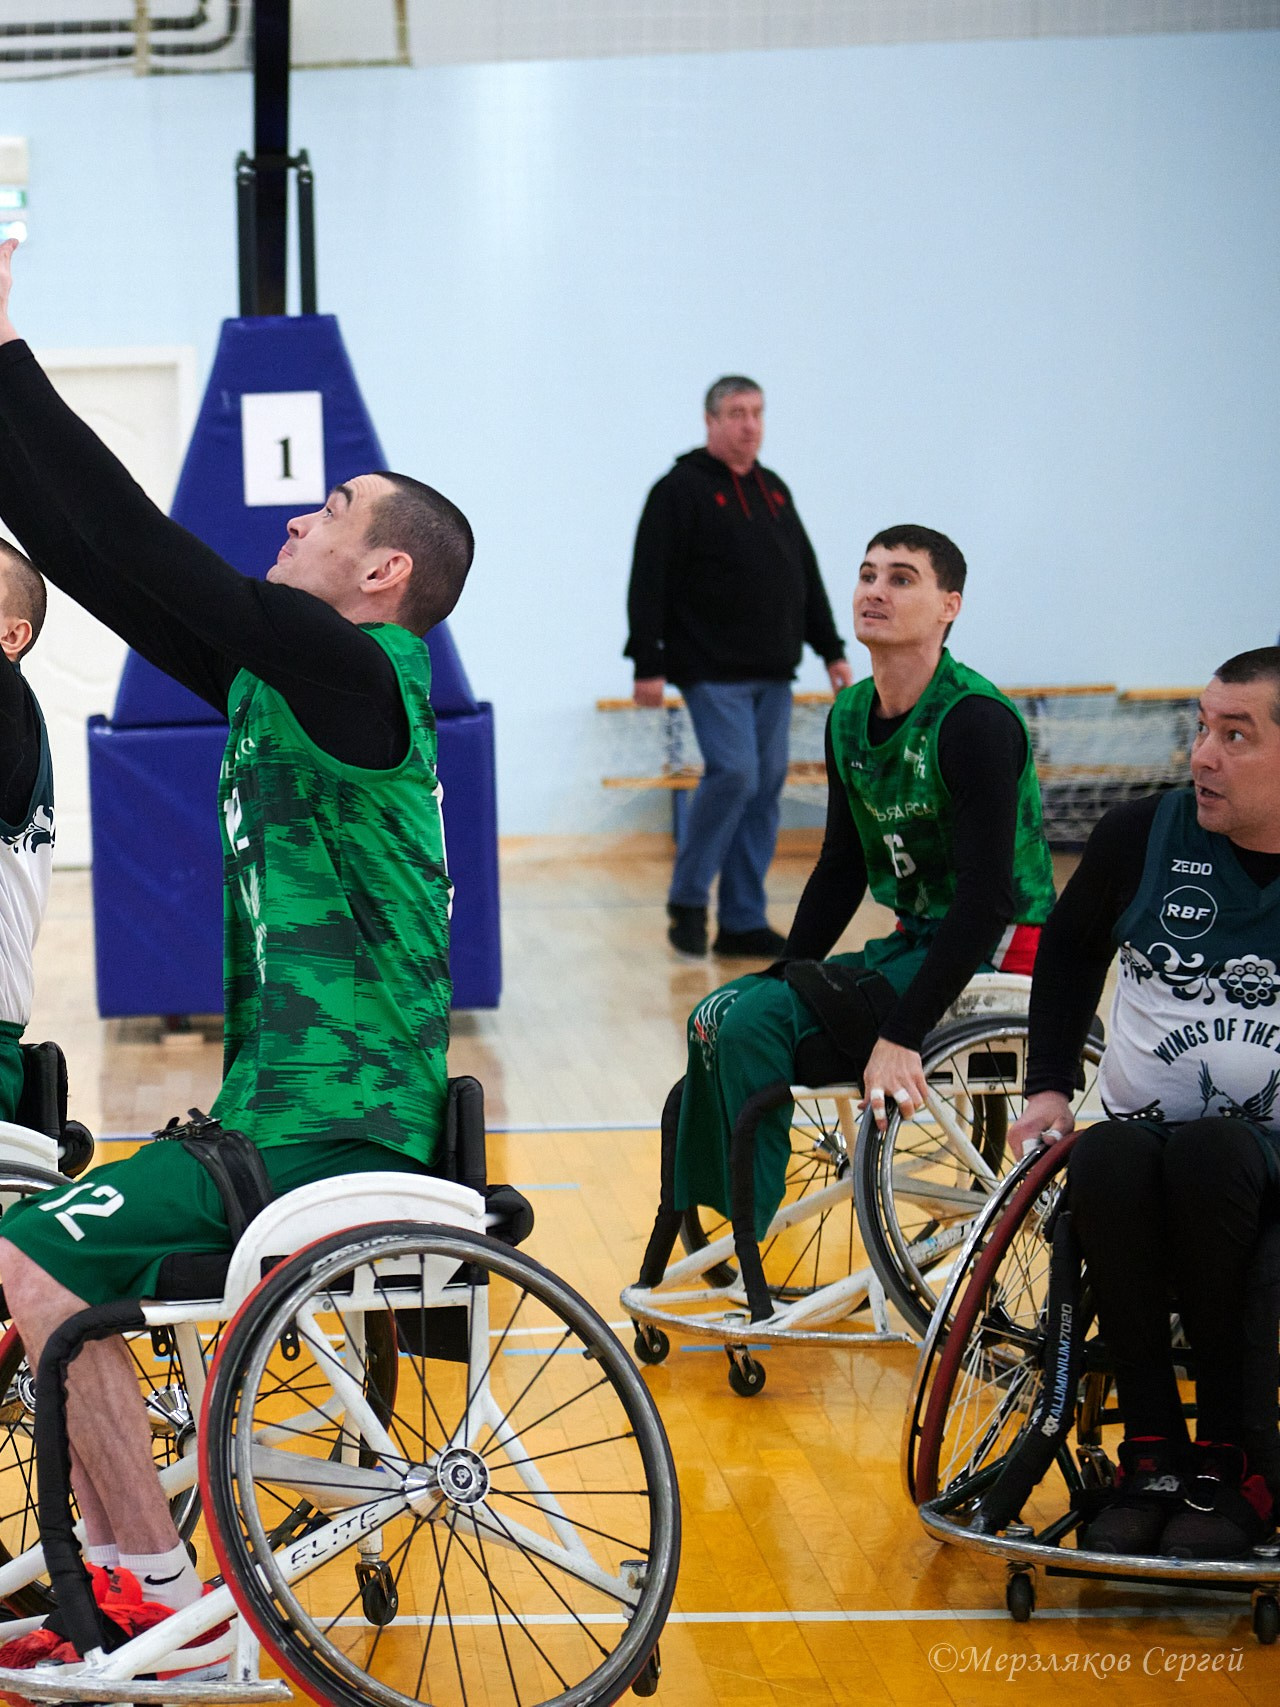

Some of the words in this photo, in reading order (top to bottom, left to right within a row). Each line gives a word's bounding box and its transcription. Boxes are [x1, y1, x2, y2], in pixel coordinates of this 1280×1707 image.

[276, 437, 296, 480] 1
[1171, 859, 1213, 876] ZEDO
[1166, 903, 1211, 921] RBF
[1153, 1020, 1209, 1066] WINGS
[1214, 1017, 1237, 1041] OF
[1241, 1019, 1280, 1048] THE
[38, 1183, 125, 1242] 12
